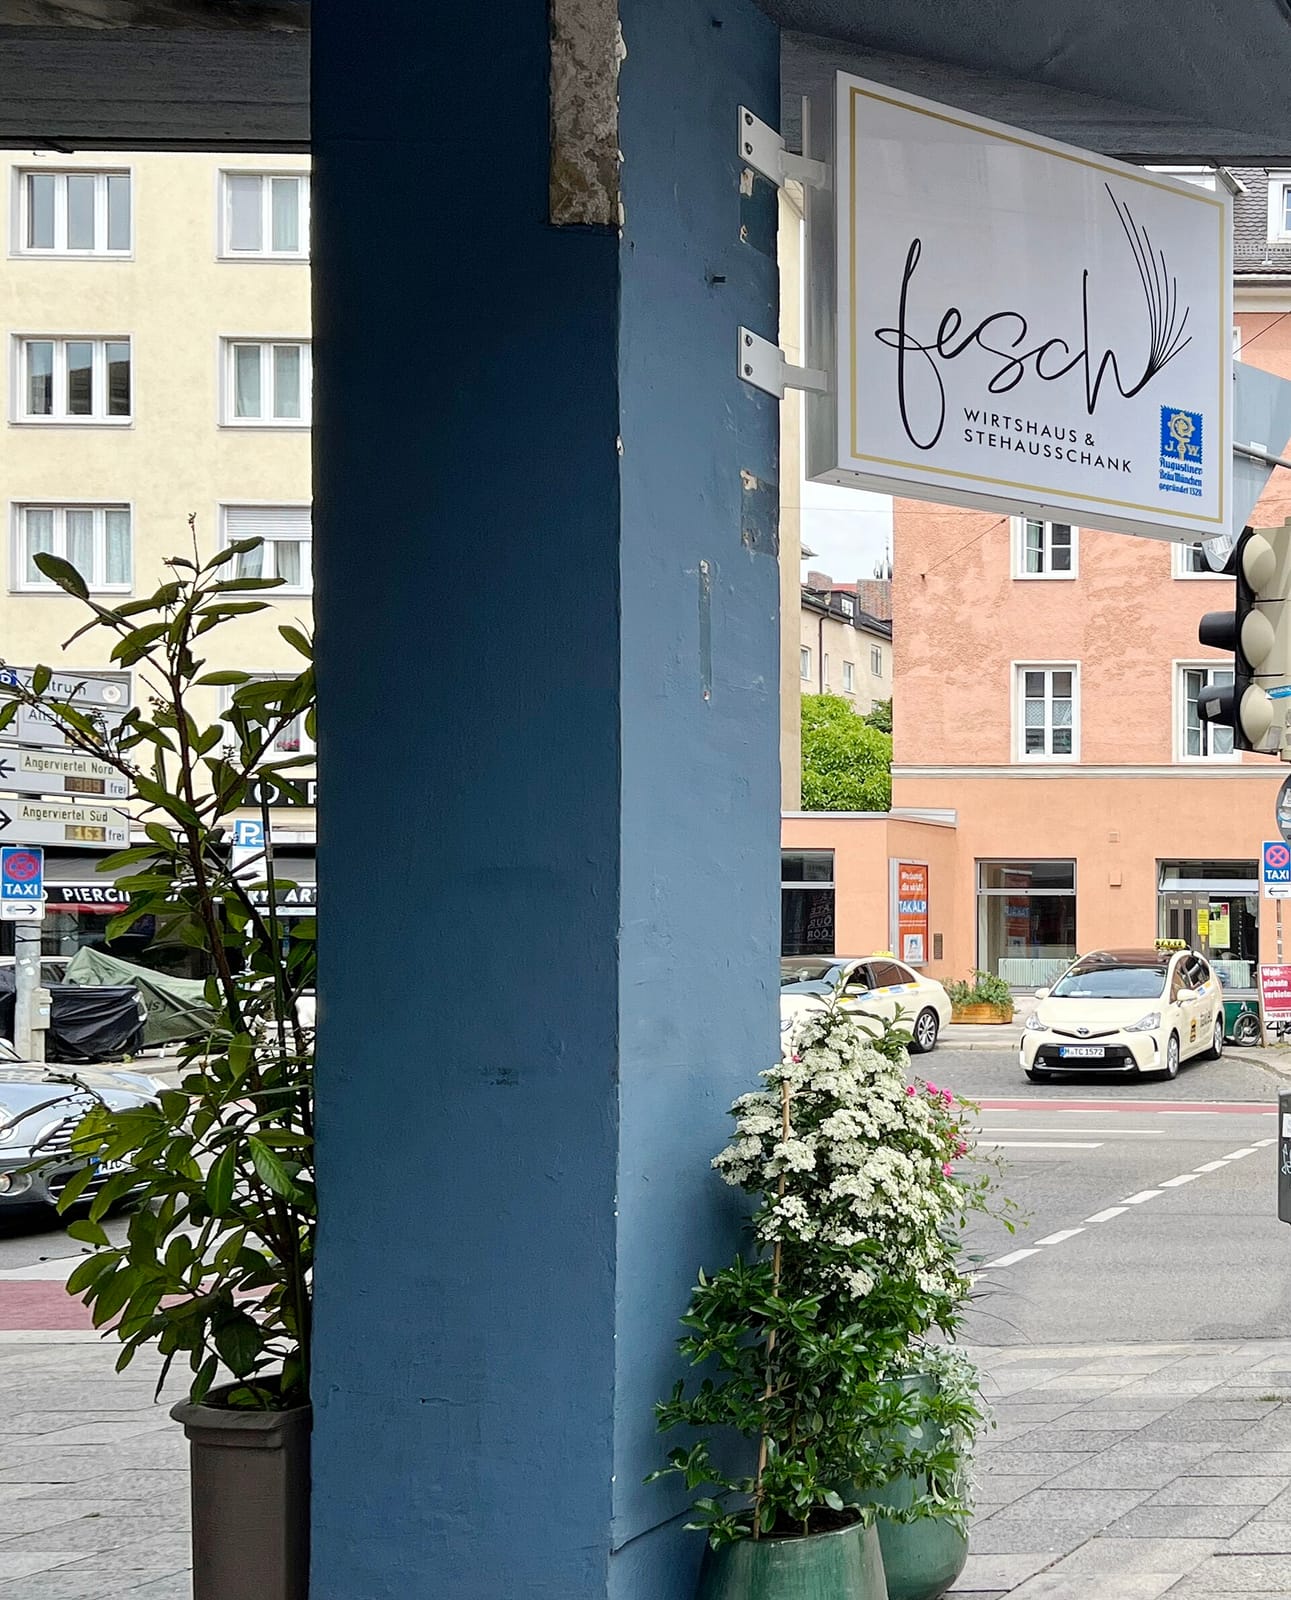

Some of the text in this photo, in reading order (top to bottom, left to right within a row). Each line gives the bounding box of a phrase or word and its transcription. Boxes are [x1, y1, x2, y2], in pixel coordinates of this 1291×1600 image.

[875, 238, 1158, 450] fesch
[963, 407, 1095, 447] WIRTSHAUS &
[963, 429, 1133, 473] STEHAUSSCHANK
[1159, 457, 1203, 475] Augustiner
[25, 756, 114, 775] Angerviertel Nord
[110, 783, 126, 794] frei
[23, 806, 108, 822] Angerviertel Süd
[108, 830, 124, 841] frei
[240, 823, 260, 845] P
[1265, 870, 1289, 880] TAXI
[4, 884, 38, 895] TAXI
